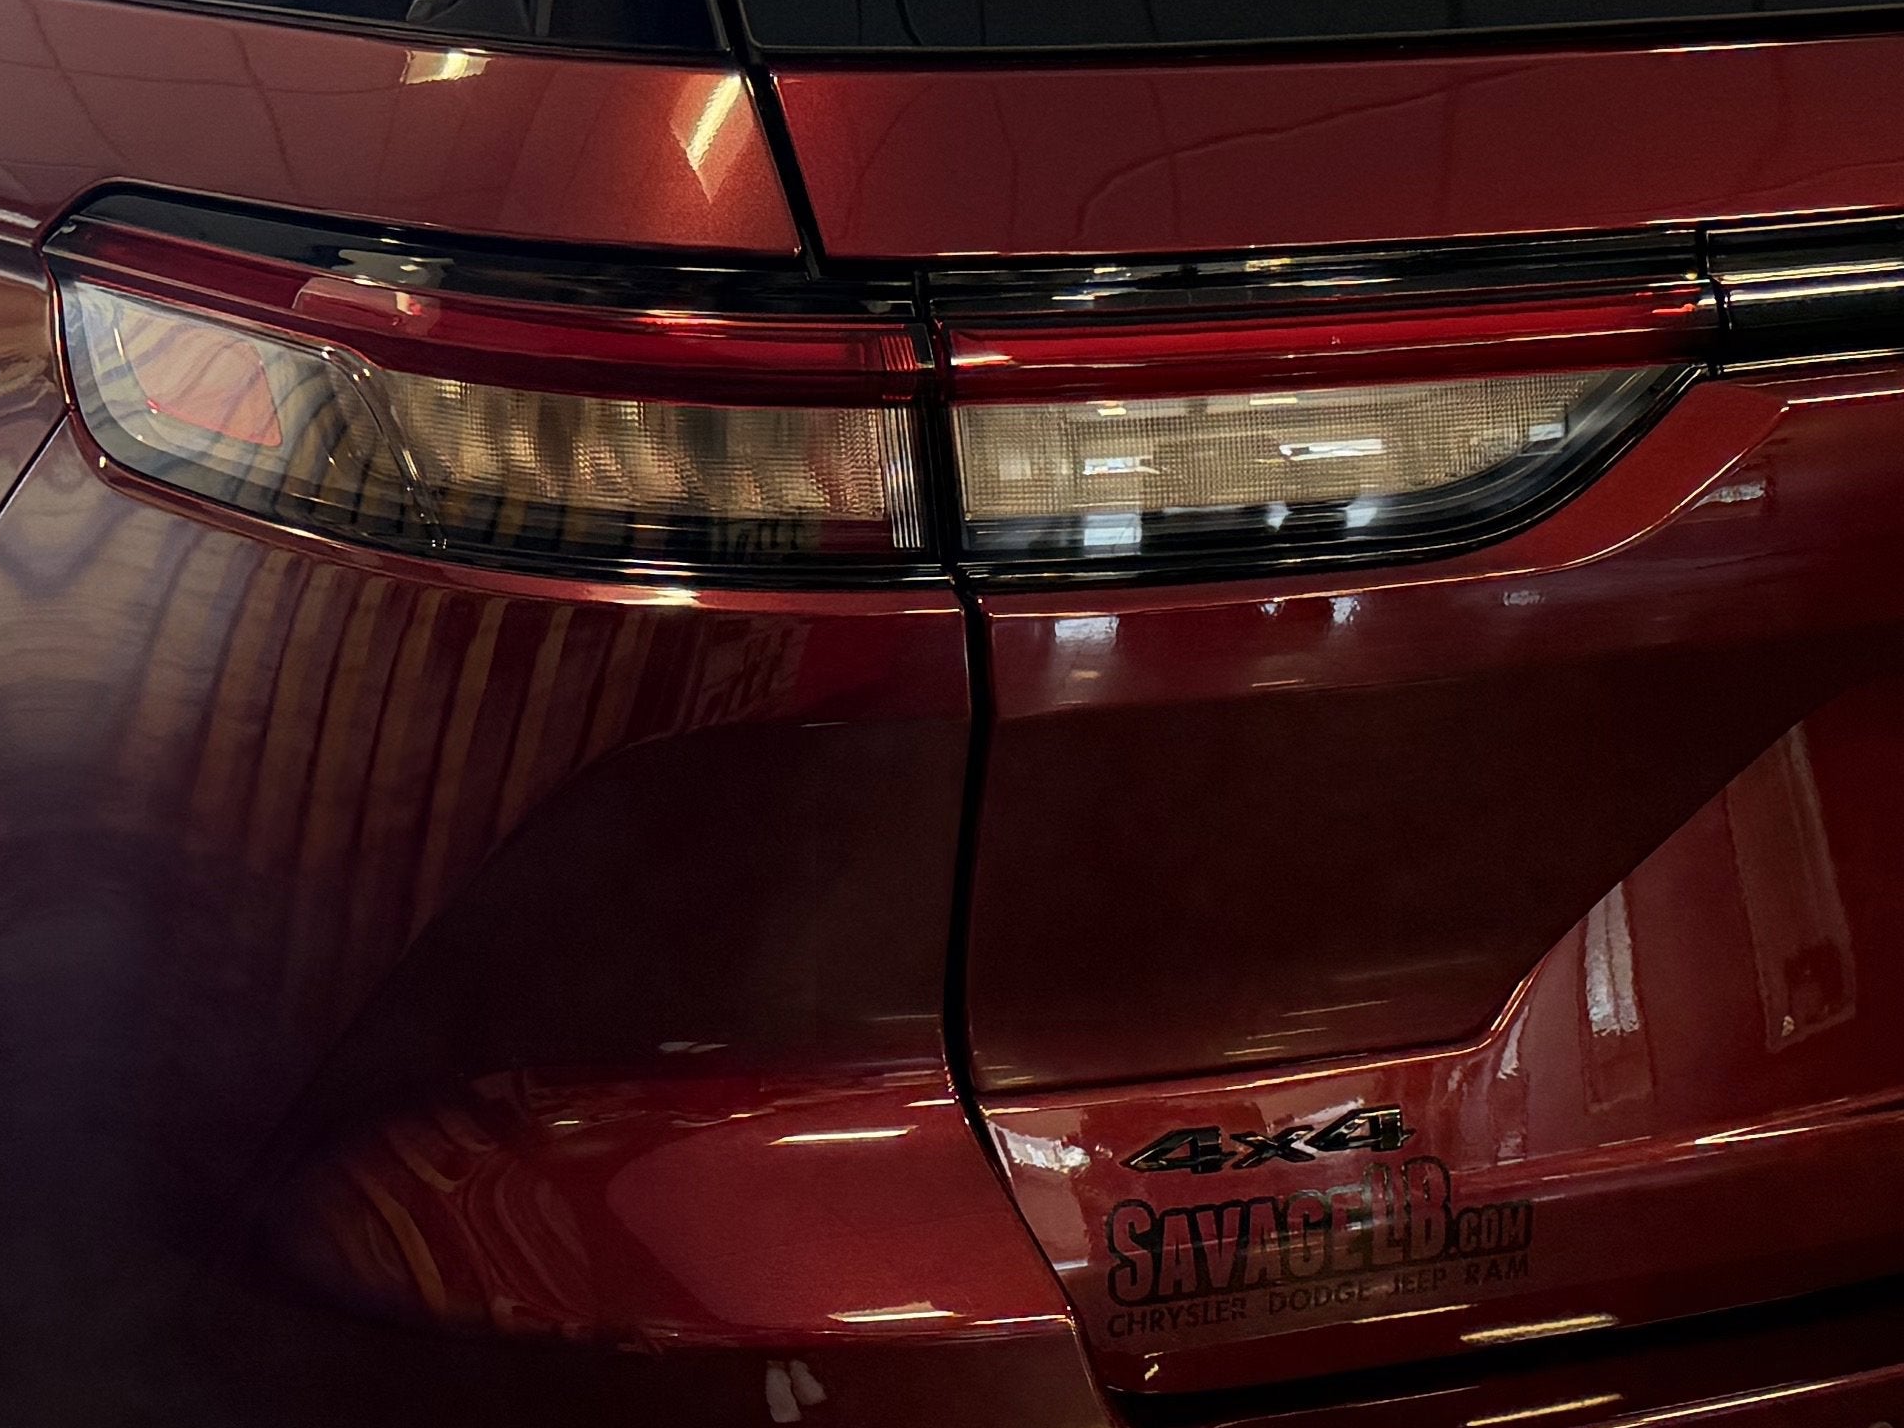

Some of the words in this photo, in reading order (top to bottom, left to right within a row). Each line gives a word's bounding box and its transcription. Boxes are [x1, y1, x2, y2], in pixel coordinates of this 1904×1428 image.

[1106, 1295, 1249, 1340] CHRYSLER
[1268, 1271, 1373, 1316] DODGE
[1389, 1270, 1448, 1299] JEEP
[1462, 1252, 1531, 1285] RAM
